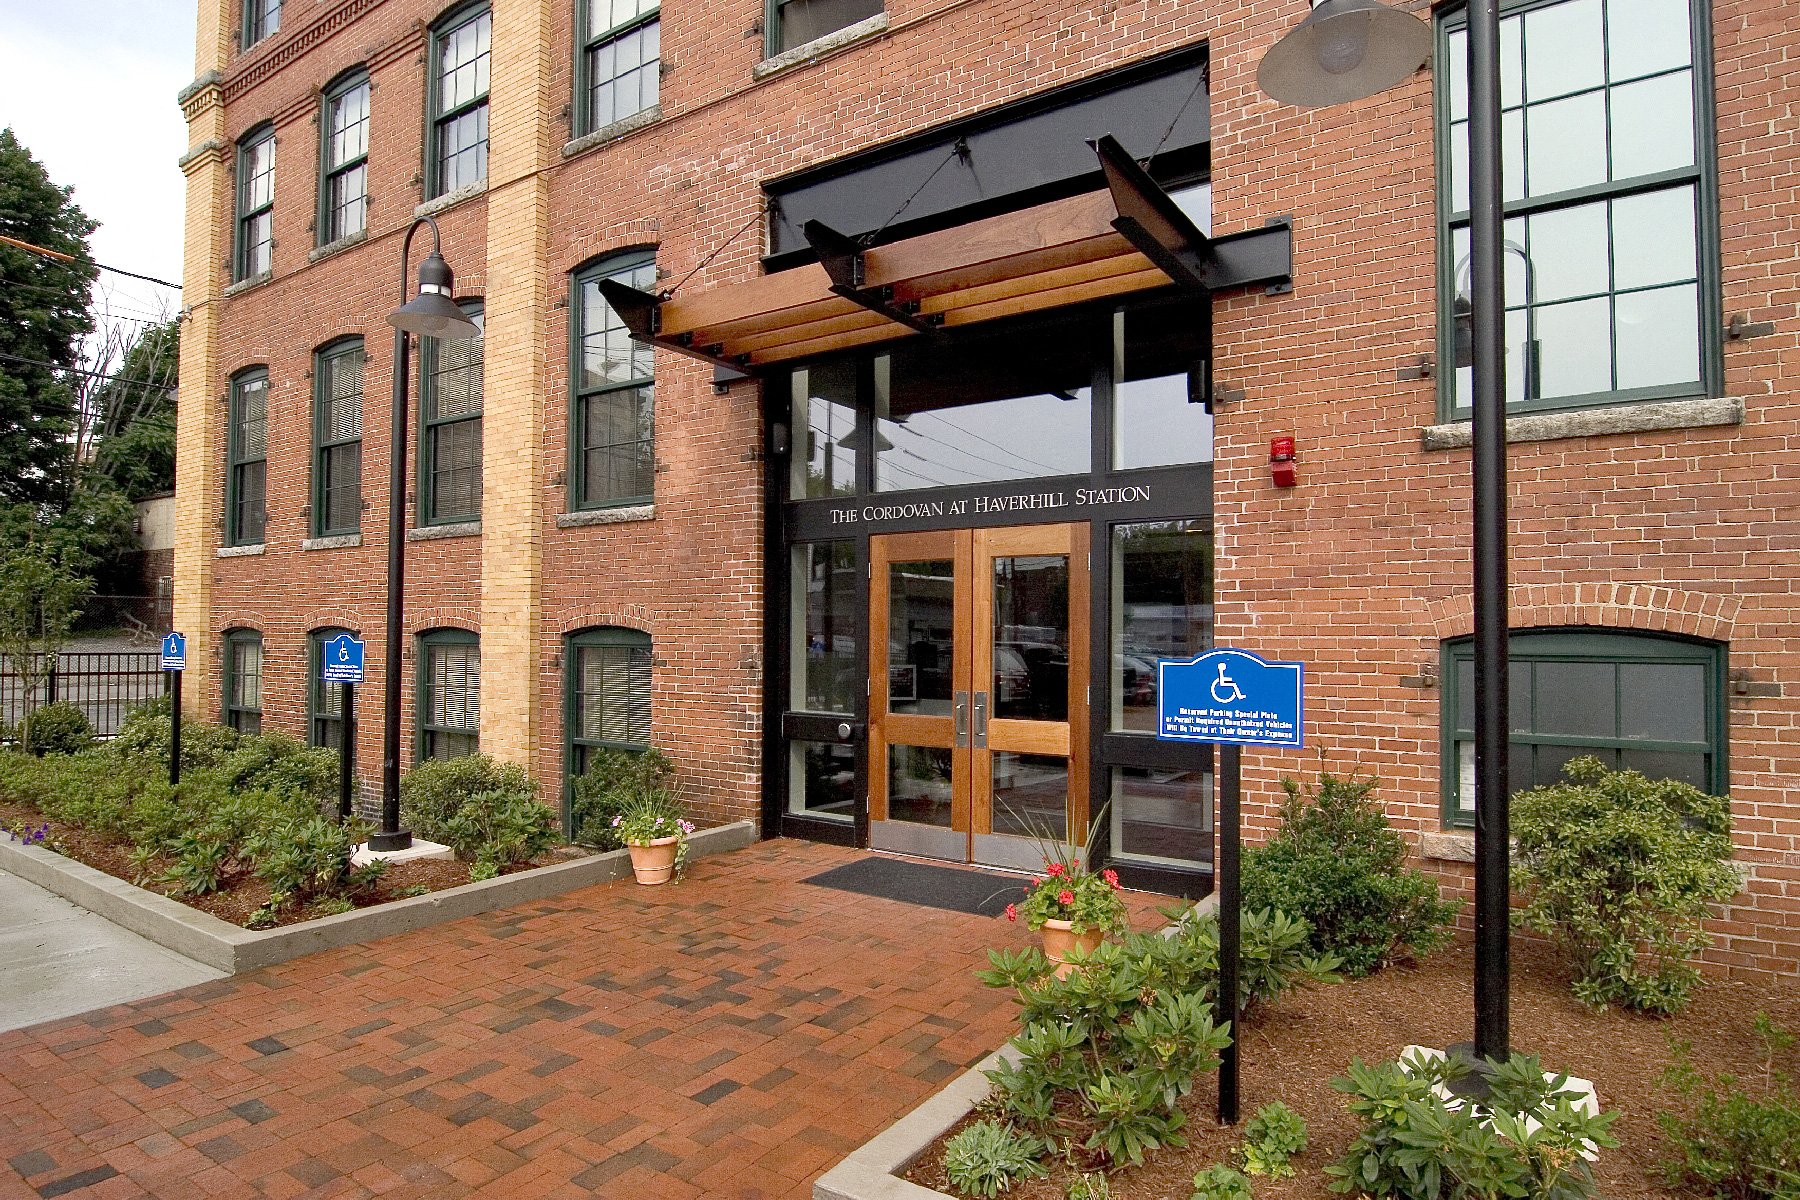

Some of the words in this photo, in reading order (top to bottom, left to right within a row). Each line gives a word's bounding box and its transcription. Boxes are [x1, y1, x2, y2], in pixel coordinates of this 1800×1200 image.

[830, 509, 858, 524] THE
[862, 501, 944, 521] CORDOVAN
[949, 500, 968, 515] AT
[974, 492, 1069, 513] HAVERHILL
[1075, 485, 1151, 505] STATION
[1210, 709, 1232, 718] Parking
[1234, 710, 1258, 718] Special
[1260, 712, 1278, 720] Plate
[1196, 717, 1224, 725] Required
[1265, 720, 1293, 728] Vehicles
[1190, 726, 1208, 734] Towed
[1219, 727, 1235, 735] Their
[1236, 728, 1264, 736] Owner's
[1265, 730, 1292, 738] Expense
